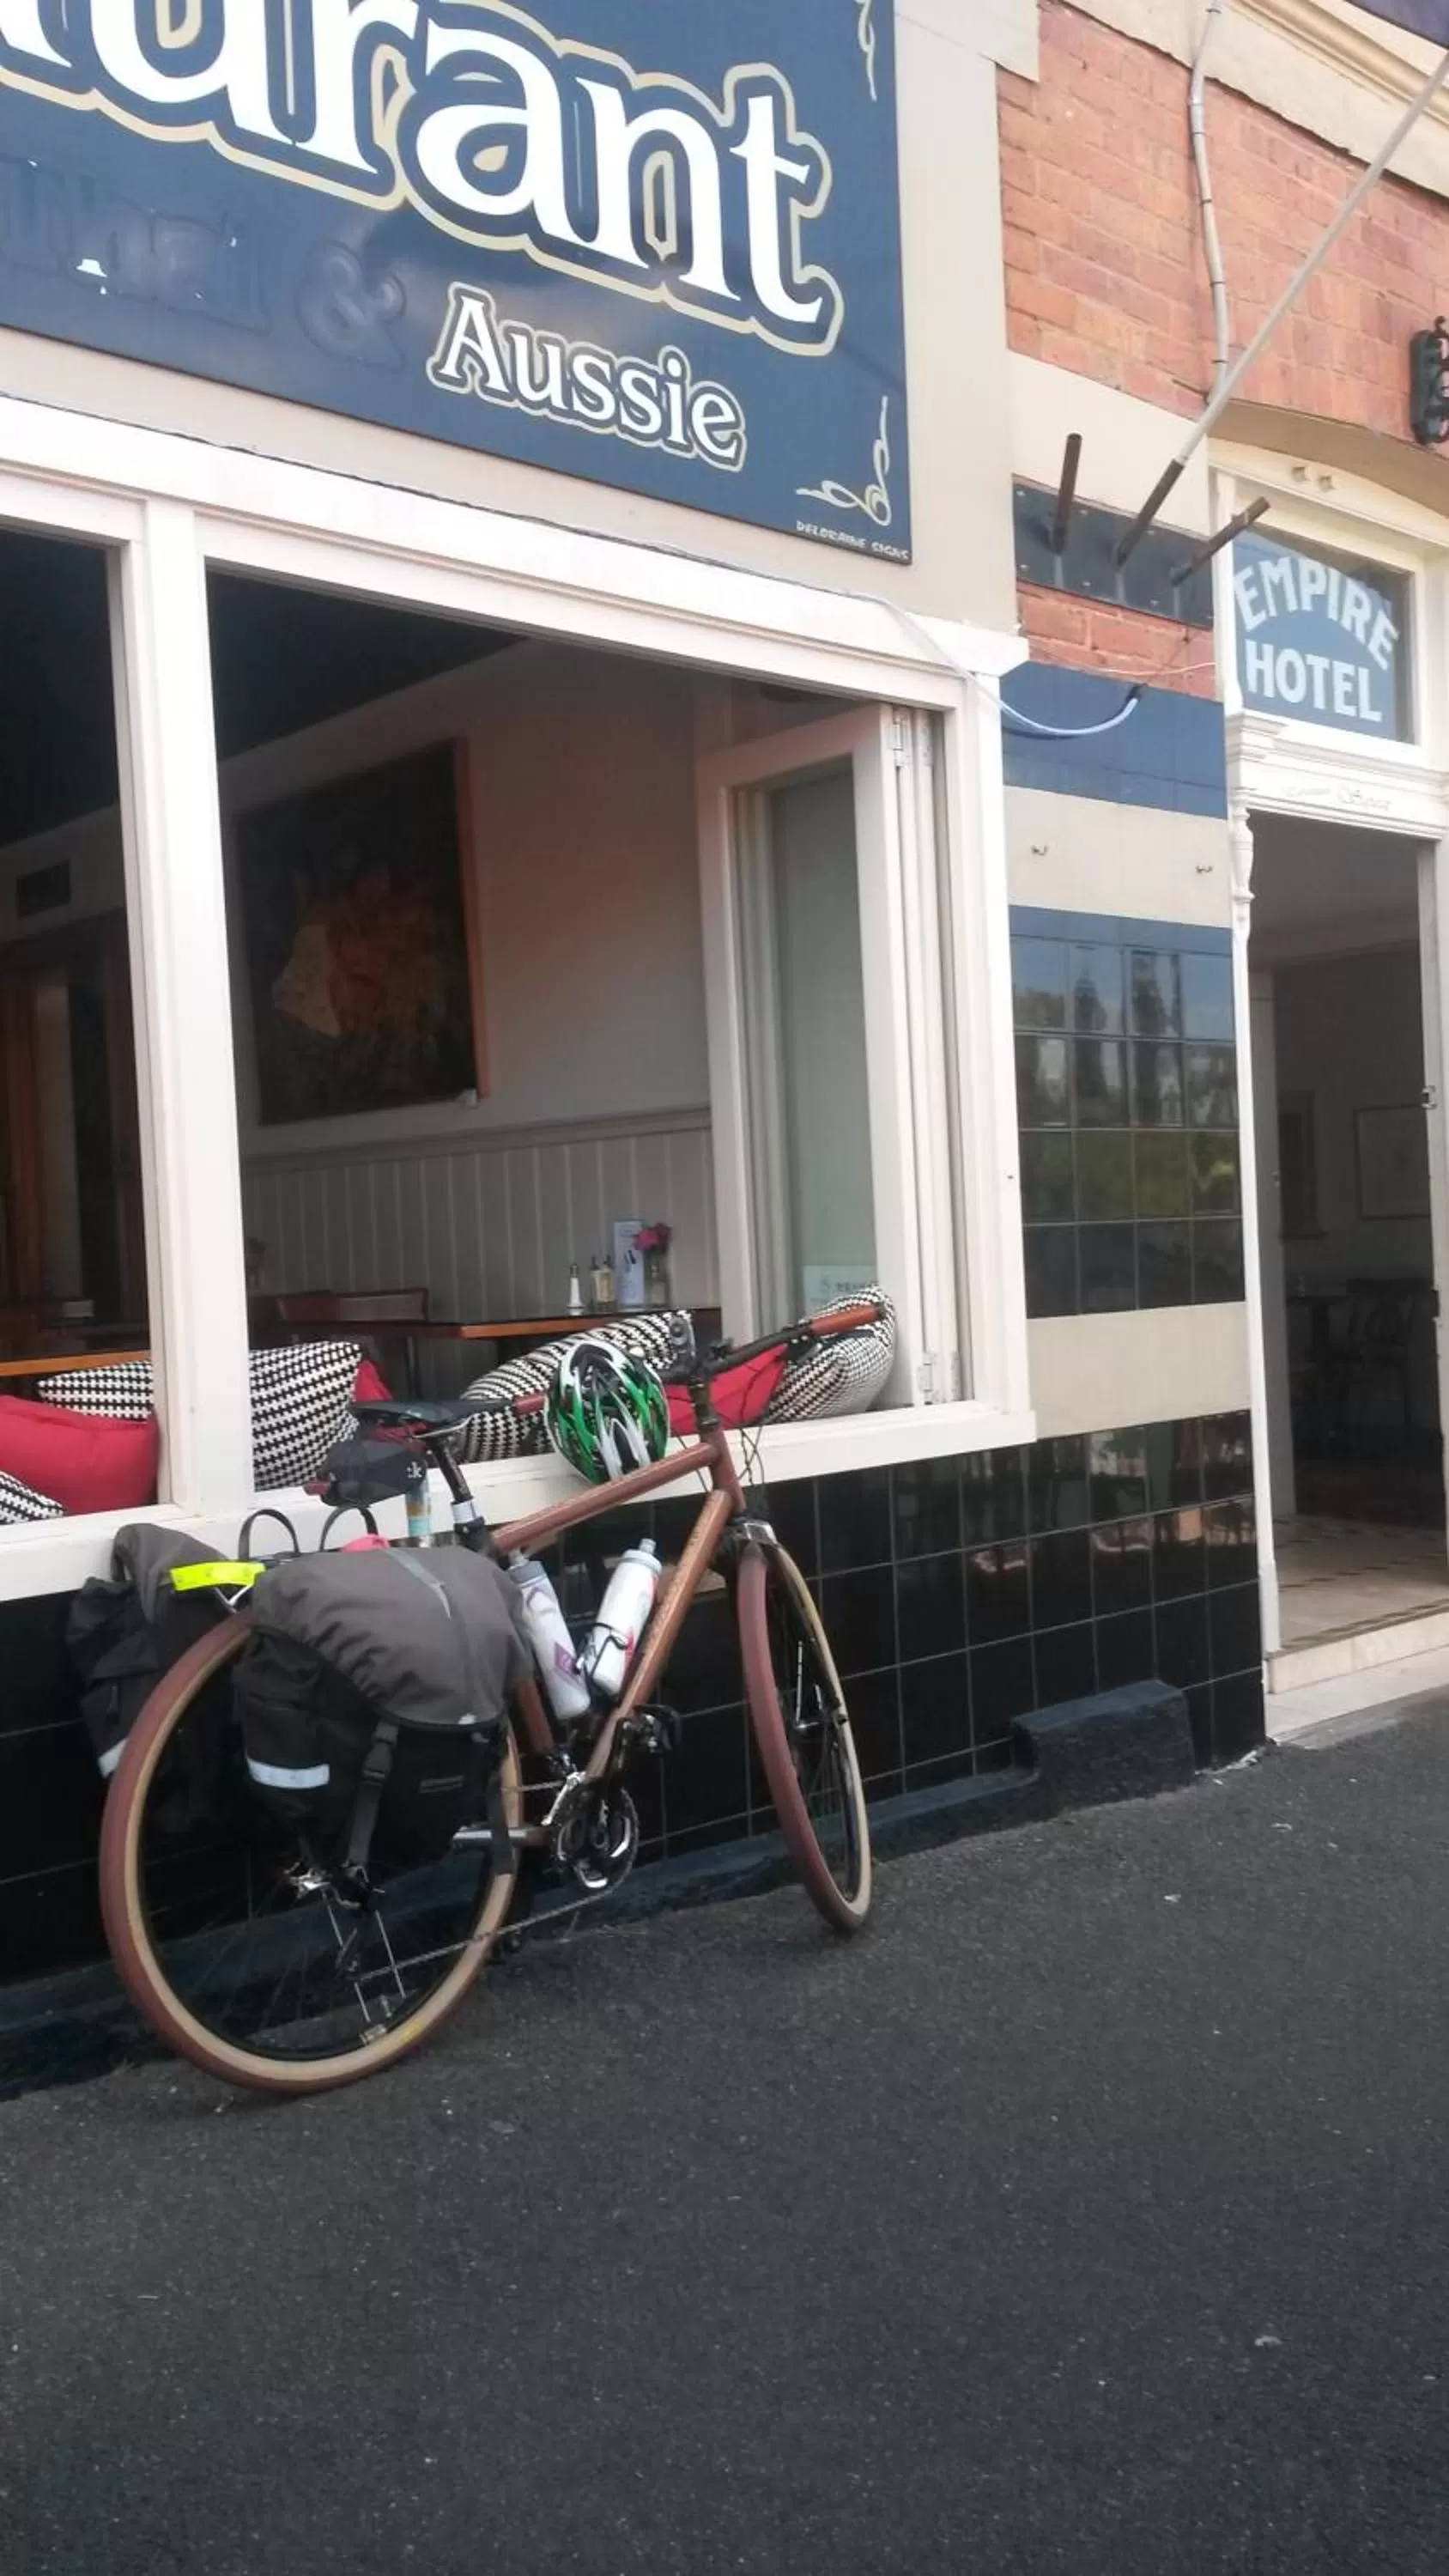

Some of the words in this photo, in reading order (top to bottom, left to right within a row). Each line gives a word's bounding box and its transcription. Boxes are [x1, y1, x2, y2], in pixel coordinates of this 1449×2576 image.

[0, 0, 822, 325] urant
[433, 295, 743, 459] Aussie
[796, 519, 866, 549] DELORAINE
[871, 542, 909, 560] SIGNS
[1233, 556, 1400, 671] EMPIRE
[1244, 638, 1383, 723] HOTEL
